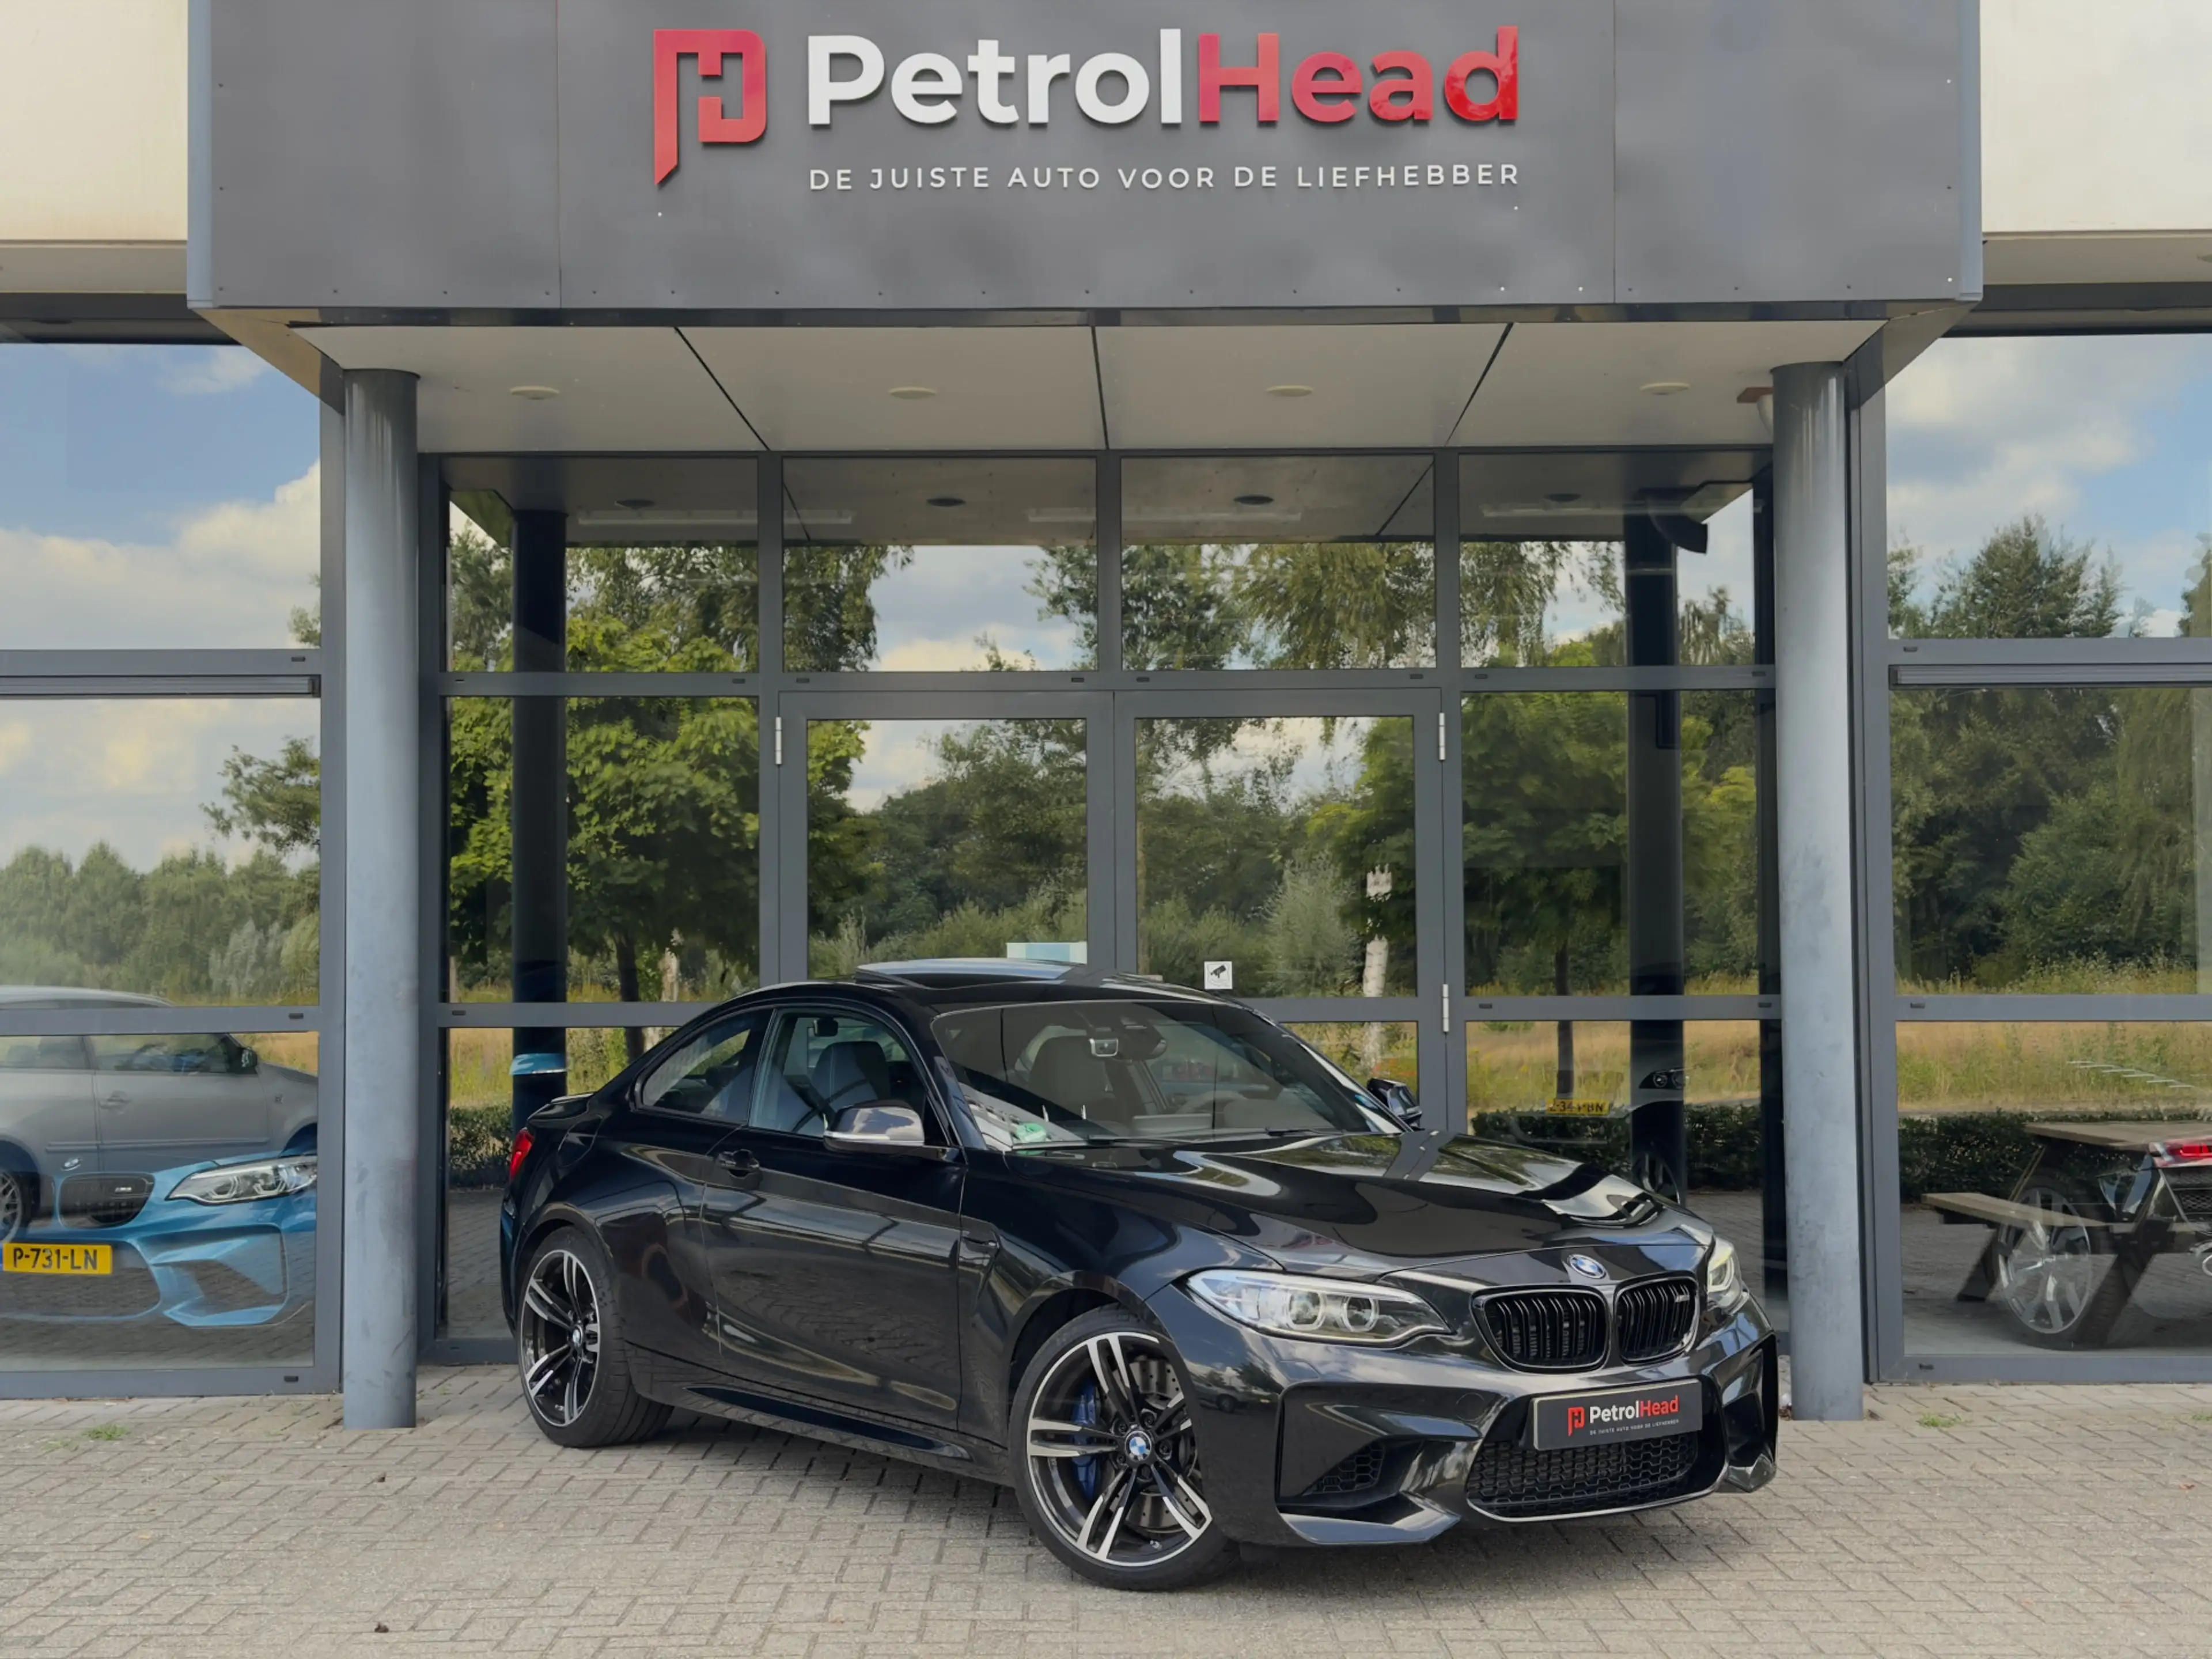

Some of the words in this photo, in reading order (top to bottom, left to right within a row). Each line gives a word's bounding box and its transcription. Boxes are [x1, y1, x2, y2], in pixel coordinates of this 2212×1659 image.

[808, 26, 1518, 126] PetrolHead
[810, 169, 852, 190] DE
[870, 167, 989, 189] JUISTE
[1007, 167, 1100, 188] AUTO
[1118, 167, 1214, 189] VOOR
[1234, 166, 1277, 187] DE
[1298, 164, 1517, 187] LIEFHEBBER
[13, 1247, 98, 1270] P-731-LN
[1589, 1394, 1679, 1423] PetrolHead
